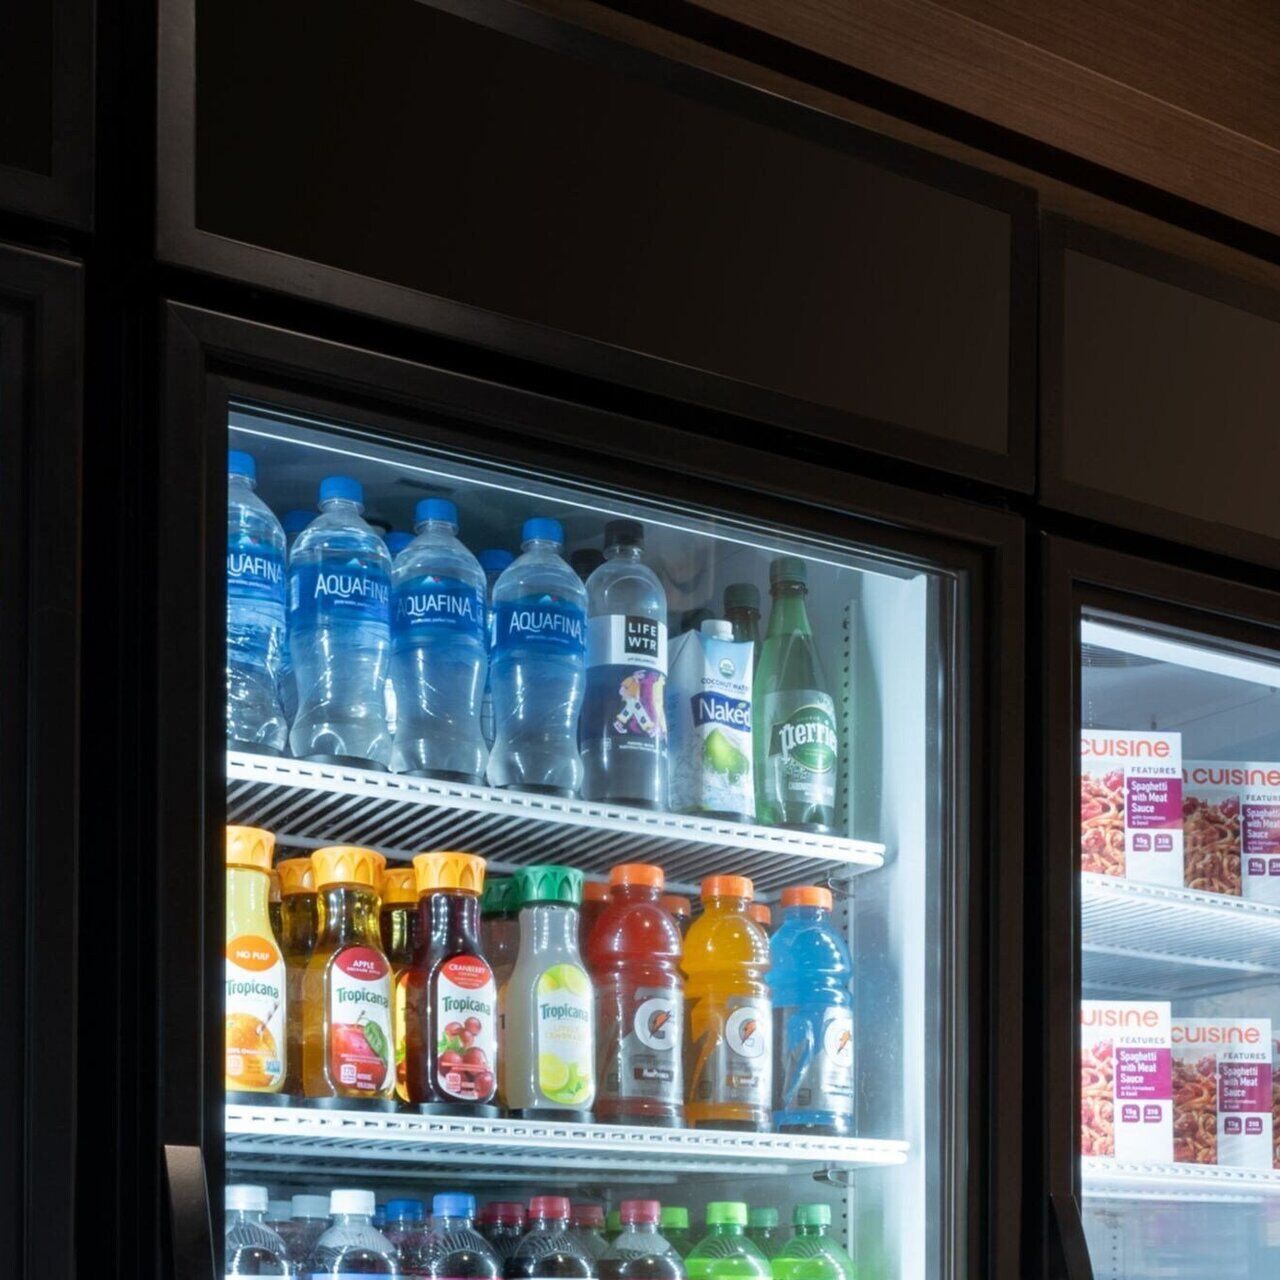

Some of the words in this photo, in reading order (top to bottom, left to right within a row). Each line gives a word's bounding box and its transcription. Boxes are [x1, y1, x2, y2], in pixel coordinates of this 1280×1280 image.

[314, 573, 390, 605] AQUAFINA
[397, 595, 472, 622] AQUAFINA
[509, 611, 584, 639] AQUAFINA
[628, 621, 657, 637] LIFE
[628, 635, 657, 651] WTR
[699, 699, 751, 726] Naked
[1131, 766, 1177, 775] FEATURES
[1131, 780, 1168, 795] Spaghetti
[1131, 803, 1155, 814] Sauce
[1247, 807, 1280, 821] Spaghetti
[1247, 829, 1269, 840] Sauce
[226, 979, 279, 999] Tropicana
[336, 987, 388, 1007] Tropicana
[442, 996, 491, 1016] Tropicana
[539, 1003, 589, 1023] Tropicana
[1120, 1037, 1166, 1045] FEATURES
[1171, 1025, 1260, 1044] cuisine
[1120, 1050, 1157, 1065] Spaghetti
[1223, 1052, 1266, 1060] FEATURES
[1120, 1073, 1144, 1084] Sauce
[1223, 1065, 1258, 1079] Spaghetti
[1223, 1086, 1246, 1097] Sauce
